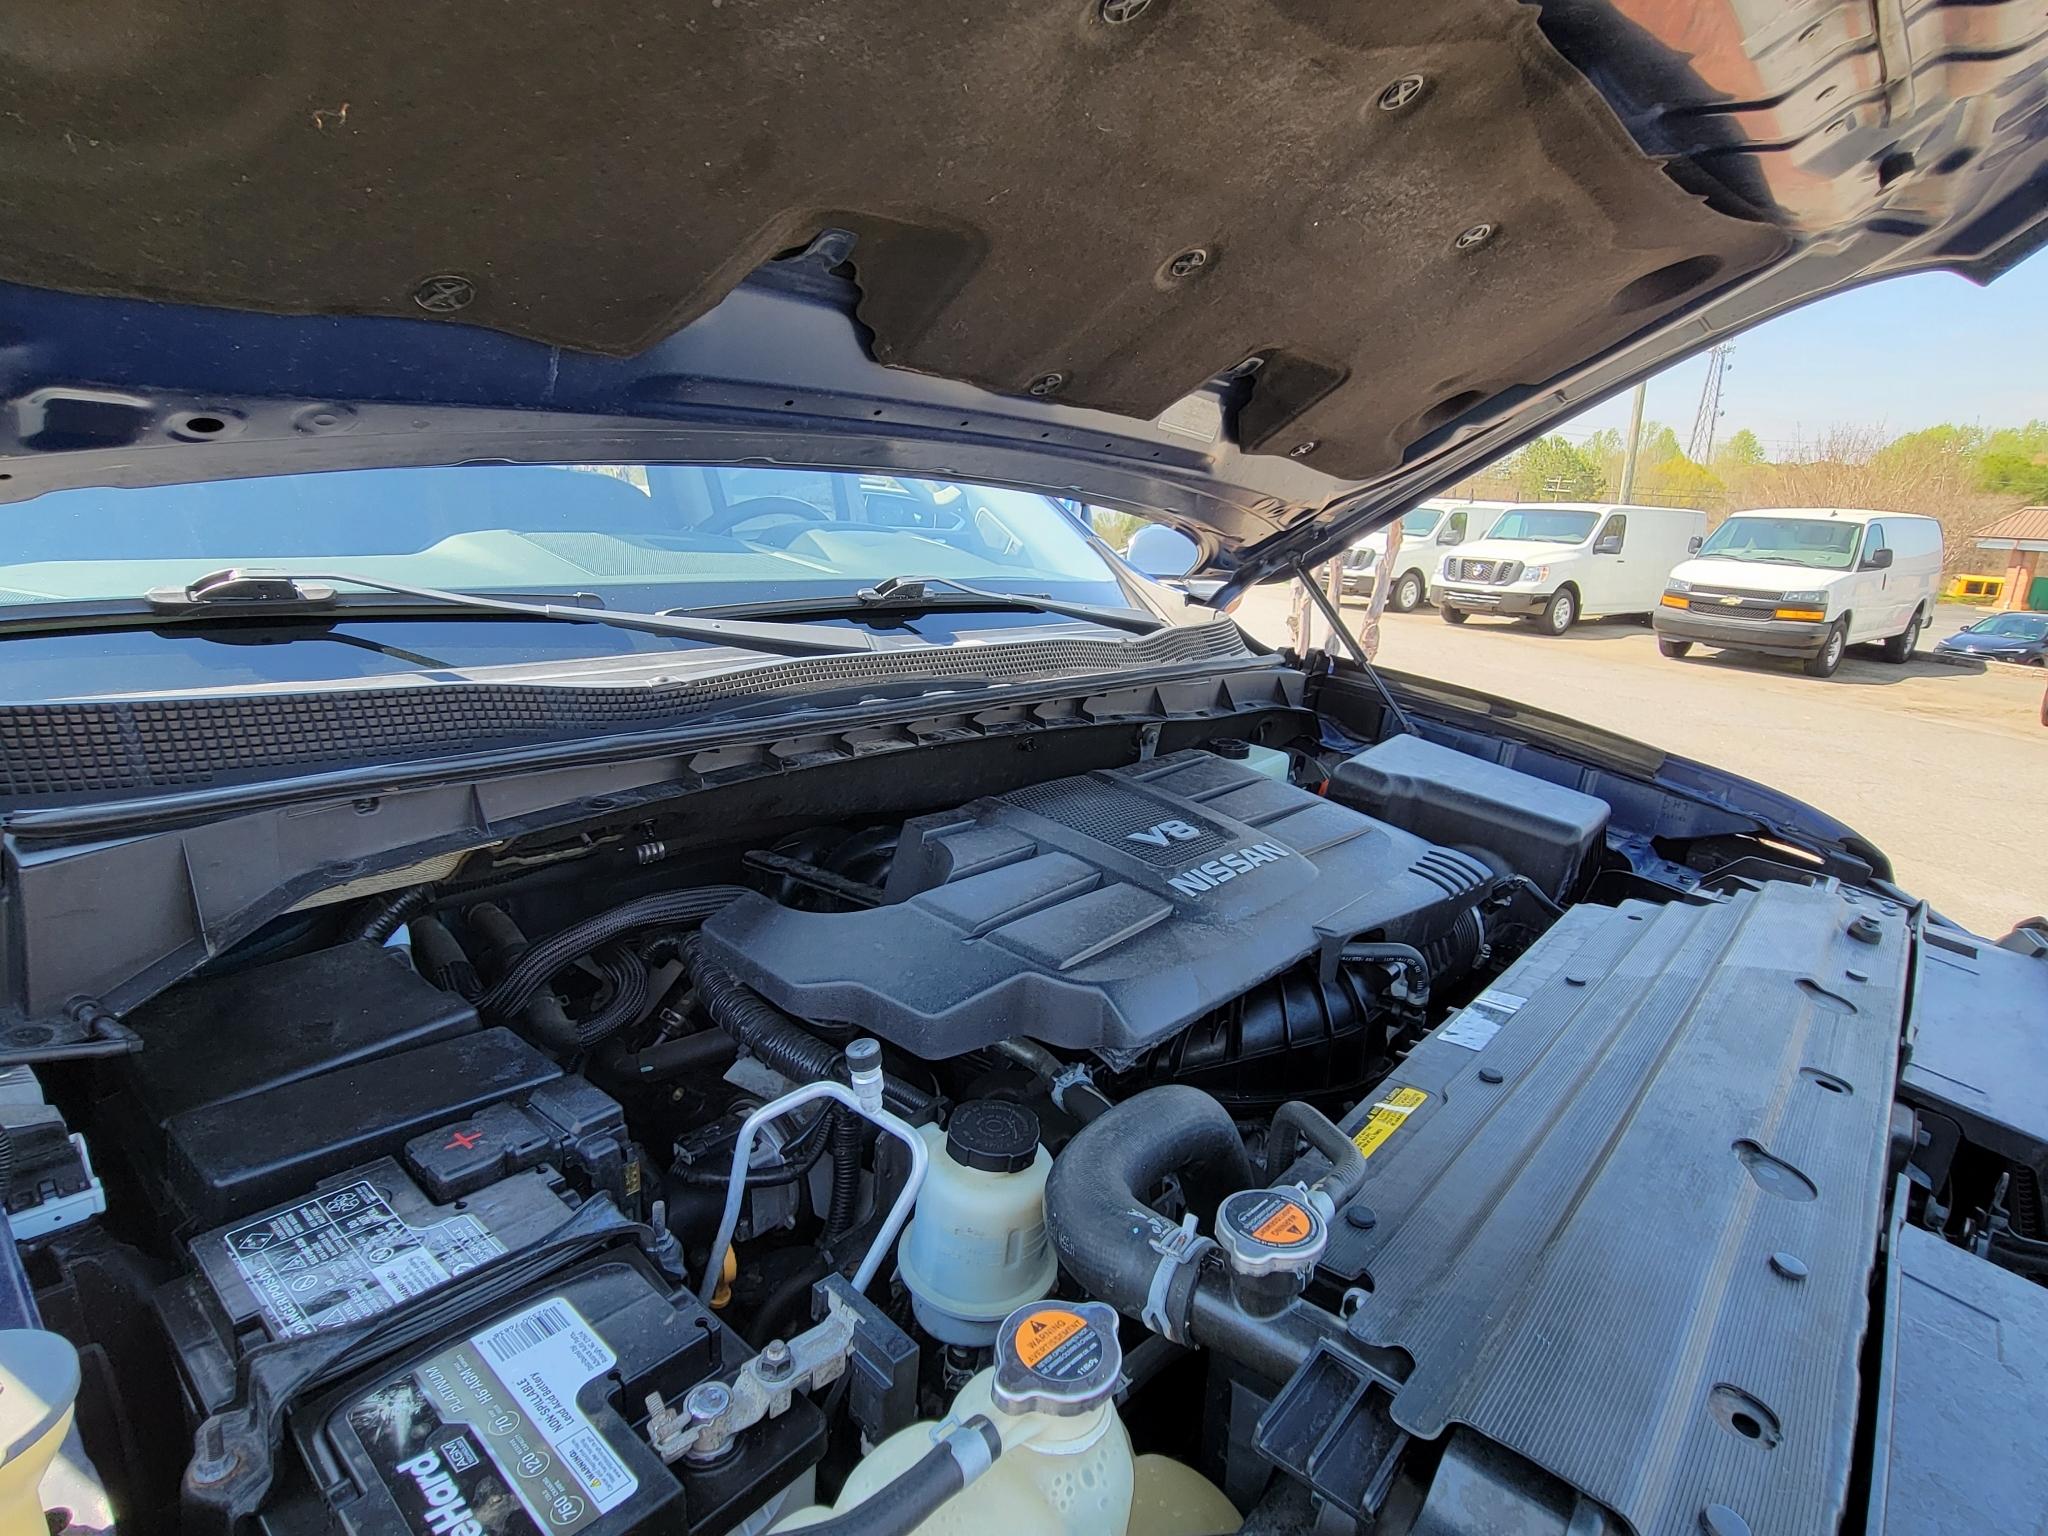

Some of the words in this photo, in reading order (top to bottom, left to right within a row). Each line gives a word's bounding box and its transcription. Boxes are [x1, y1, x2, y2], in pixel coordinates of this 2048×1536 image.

[1127, 820, 1200, 847] V8
[1167, 842, 1290, 898] NISSAN
[254, 1265, 307, 1333] DANGER/POISON
[1027, 1319, 1082, 1363] AVERTISSEMENT
[1028, 1319, 1066, 1348] WARNING
[424, 1365, 465, 1412] PLATINUM
[459, 1367, 493, 1405] H6-AGM
[528, 1370, 553, 1397] Battery
[516, 1377, 563, 1432] NON-SPILLABLE
[546, 1393, 563, 1409] Acid
[494, 1414, 512, 1431] 70
[556, 1407, 575, 1425] Lead
[444, 1442, 468, 1469] AGM
[520, 1451, 542, 1473] 120
[552, 1495, 577, 1520] 760
